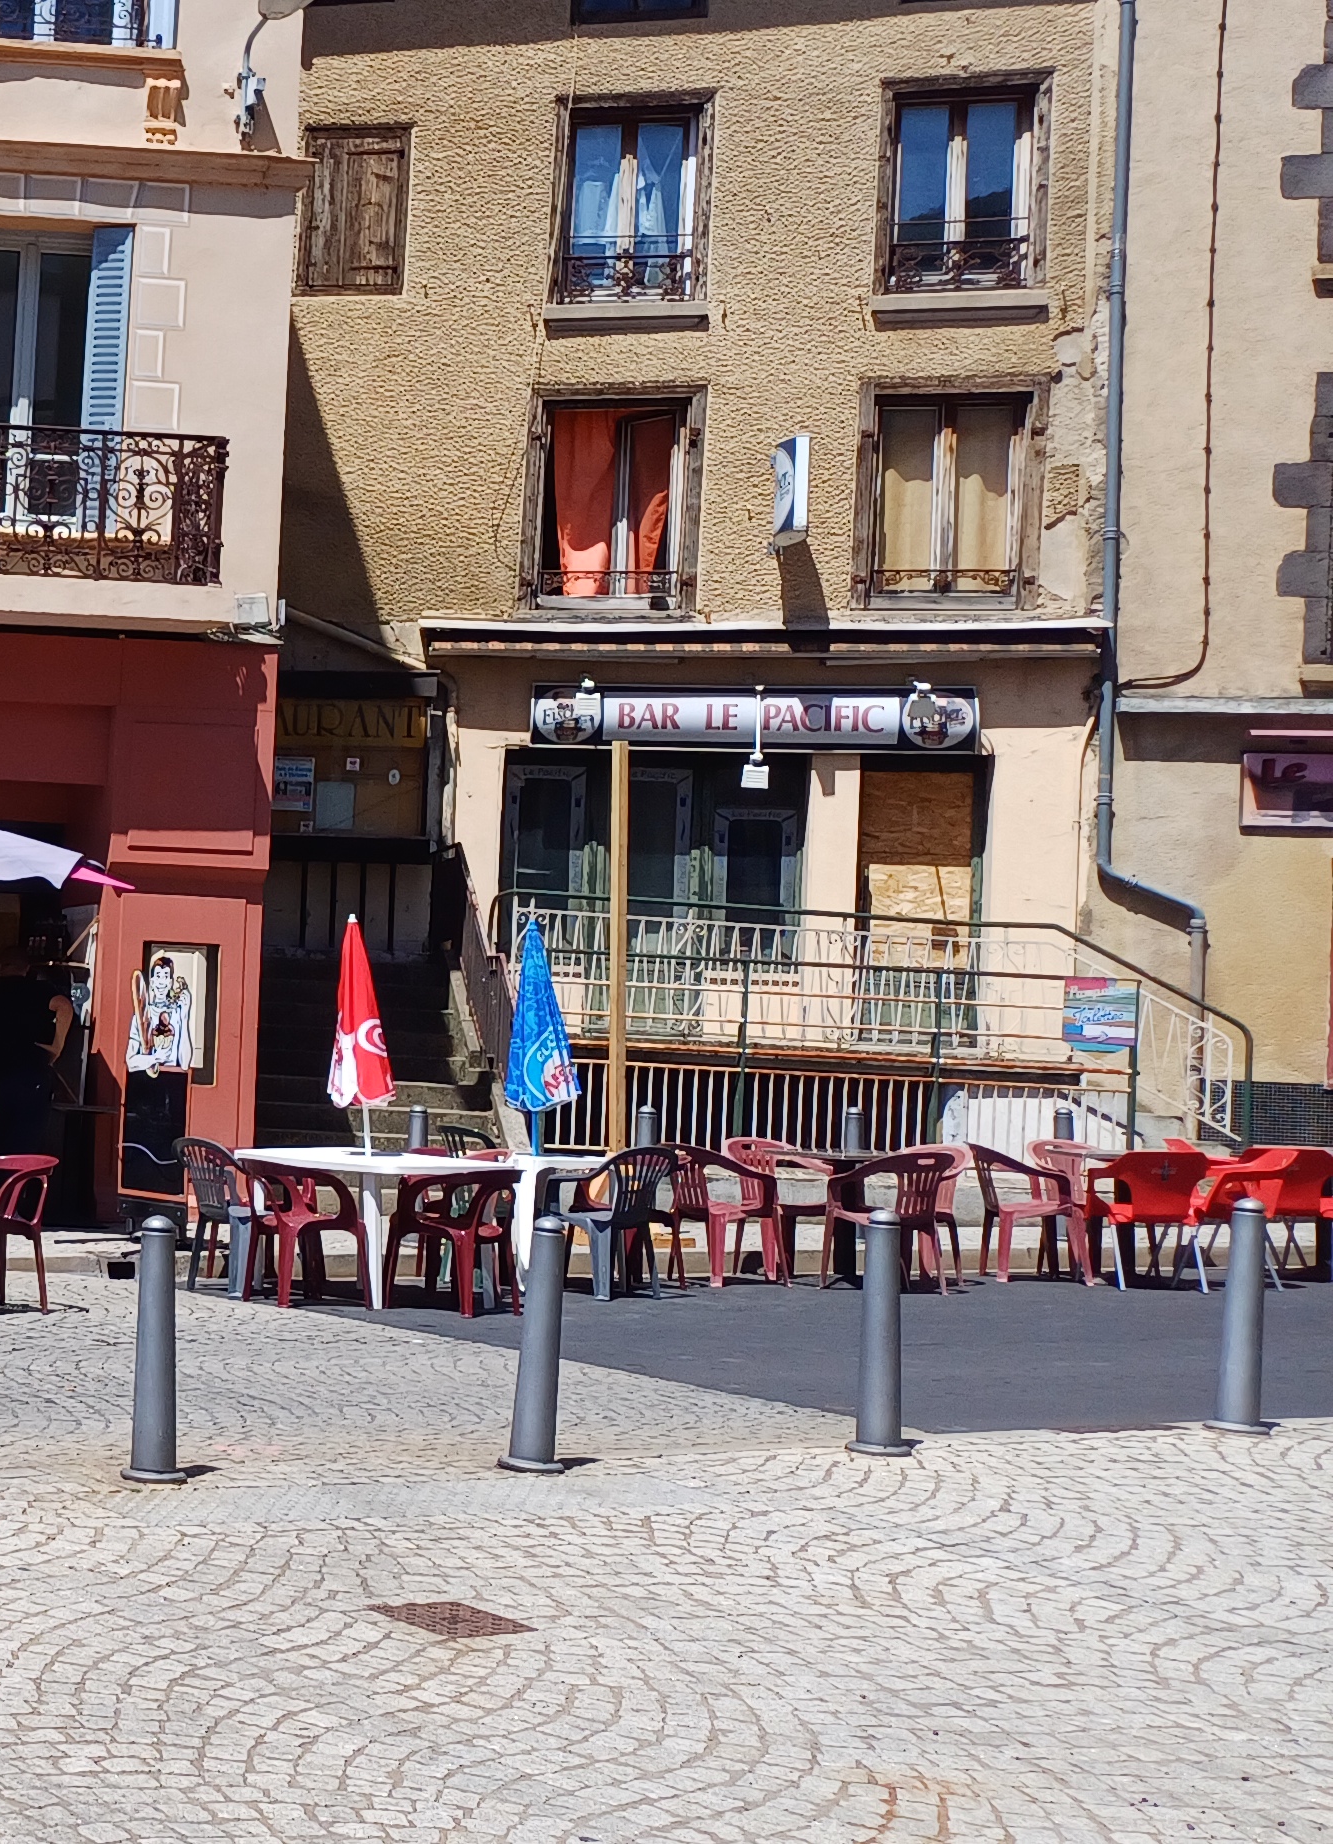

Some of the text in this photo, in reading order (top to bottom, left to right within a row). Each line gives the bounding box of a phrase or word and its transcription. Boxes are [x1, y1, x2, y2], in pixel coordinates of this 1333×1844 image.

[276, 703, 421, 740] AURANT
[618, 703, 885, 733] BAR LE PACIFIC
[1261, 758, 1308, 787] Le
